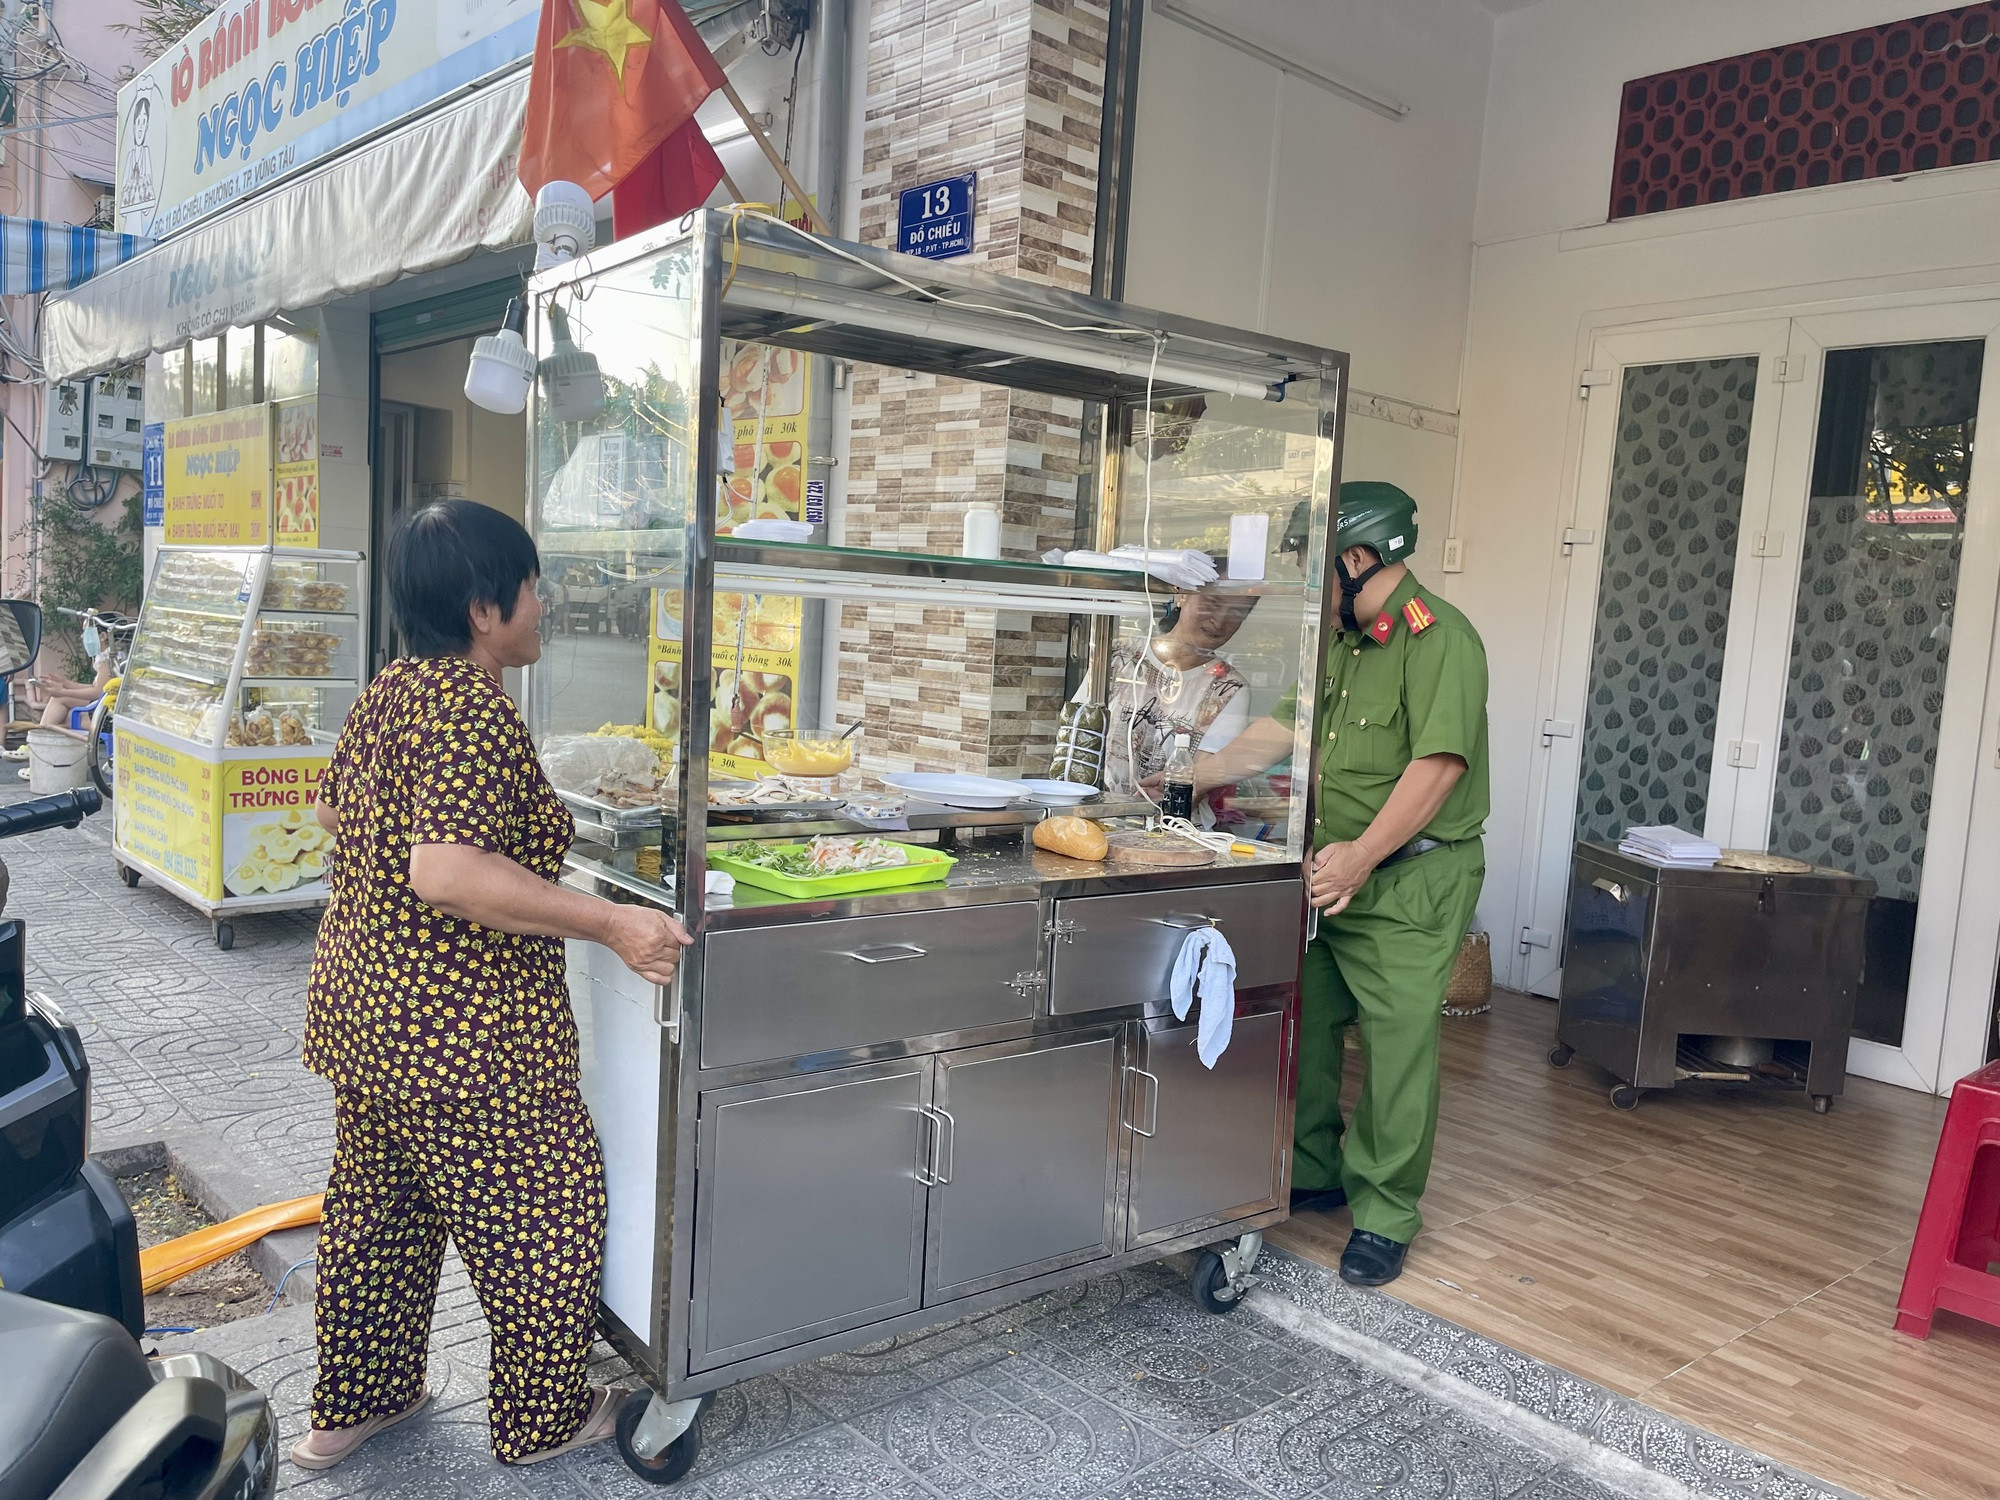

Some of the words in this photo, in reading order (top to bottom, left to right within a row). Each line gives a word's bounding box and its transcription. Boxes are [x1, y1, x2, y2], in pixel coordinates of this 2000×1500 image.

[197, 3, 260, 90] BÁNH
[194, 61, 287, 175] NGỌC
[291, 0, 397, 117] HIỆP
[165, 214, 172, 226] 11
[204, 179, 234, 209] PHƯỜNG
[255, 158, 276, 183] VŨNG
[278, 144, 295, 170] TÀU
[921, 185, 950, 219] 13
[910, 225, 925, 245] ĐỒ
[928, 216, 961, 241] CHIỂU
[201, 308, 212, 327] CÓ
[213, 306, 229, 323] CHI
[780, 421, 798, 434] 30k
[747, 653, 770, 667] bông
[776, 656, 793, 668] 30k
[720, 758, 736, 769] 30k
[242, 766, 299, 786] BÔNG
[229, 788, 300, 808] TRỨNG
